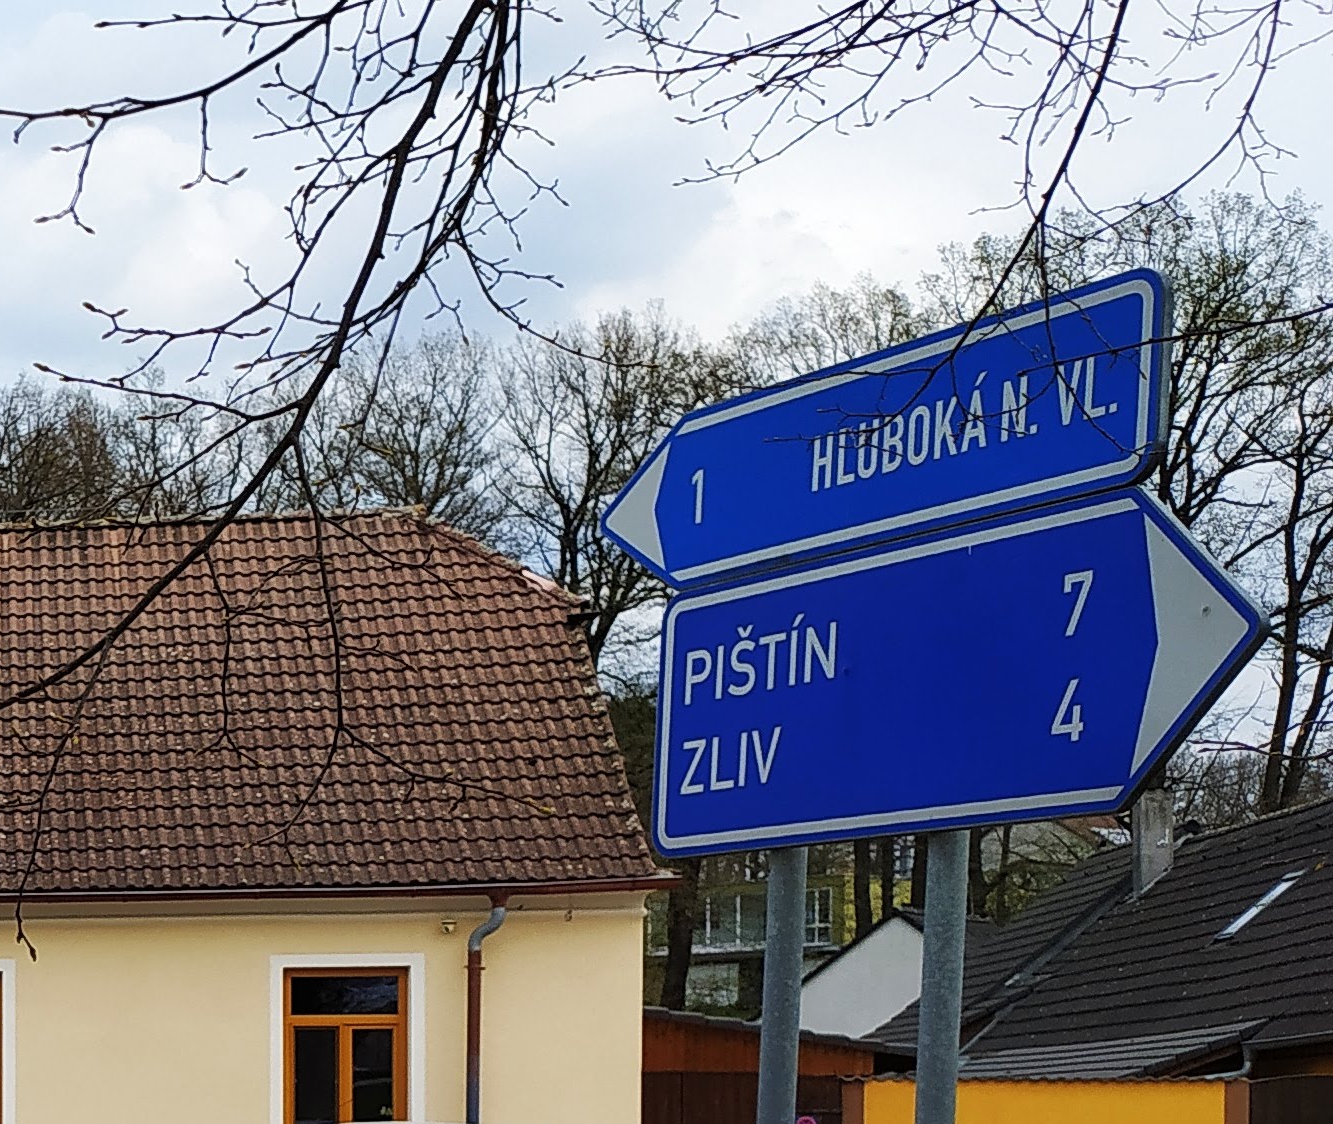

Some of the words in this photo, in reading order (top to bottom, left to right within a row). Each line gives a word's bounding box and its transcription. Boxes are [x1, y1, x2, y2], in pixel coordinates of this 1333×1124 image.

[690, 468, 705, 525] 1
[810, 371, 987, 492] HLUBOKÁ
[999, 377, 1038, 443] N.
[1058, 355, 1119, 428] VL.
[684, 614, 838, 706] PIŠTÍN
[1062, 570, 1094, 637] 7
[679, 726, 782, 796] ZLIV
[1050, 679, 1084, 743] 4
